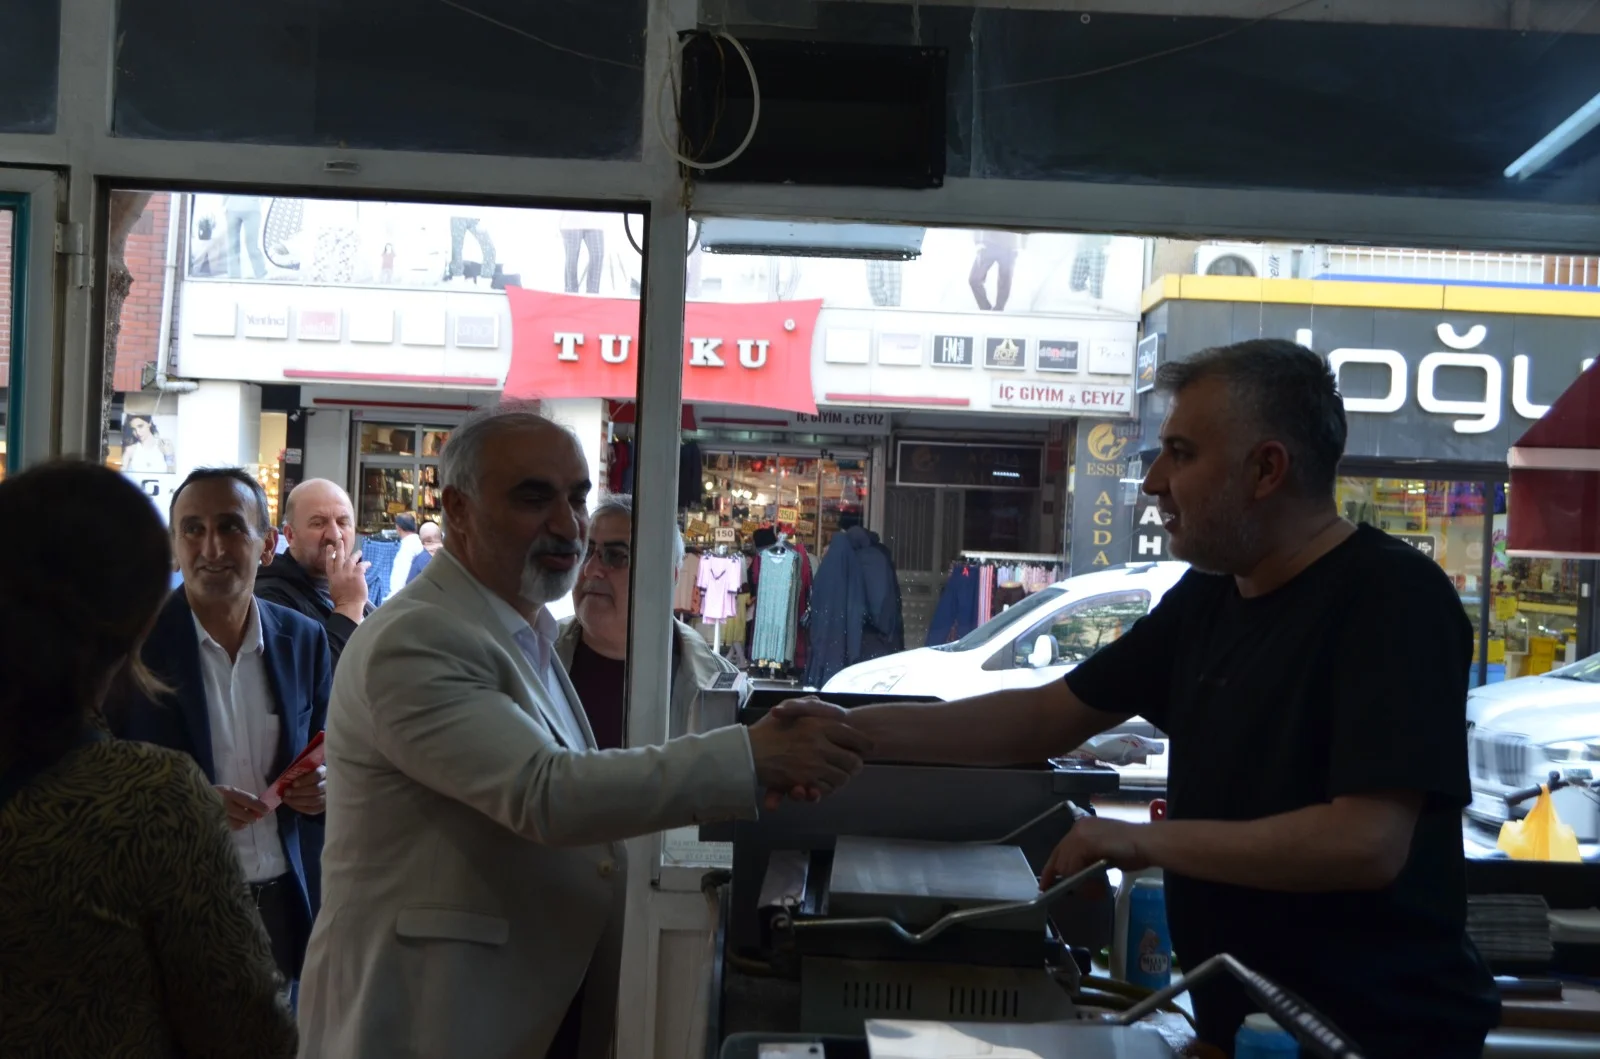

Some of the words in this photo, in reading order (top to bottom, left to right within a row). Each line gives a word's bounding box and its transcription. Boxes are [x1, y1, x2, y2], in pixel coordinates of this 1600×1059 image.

[553, 331, 770, 369] TUKU
[998, 383, 1014, 402] İÇ
[1019, 384, 1064, 402] GİYİM
[1081, 389, 1126, 406] ÇEYİZ
[853, 412, 884, 426] ÇEYİZ
[717, 529, 733, 538] 150
